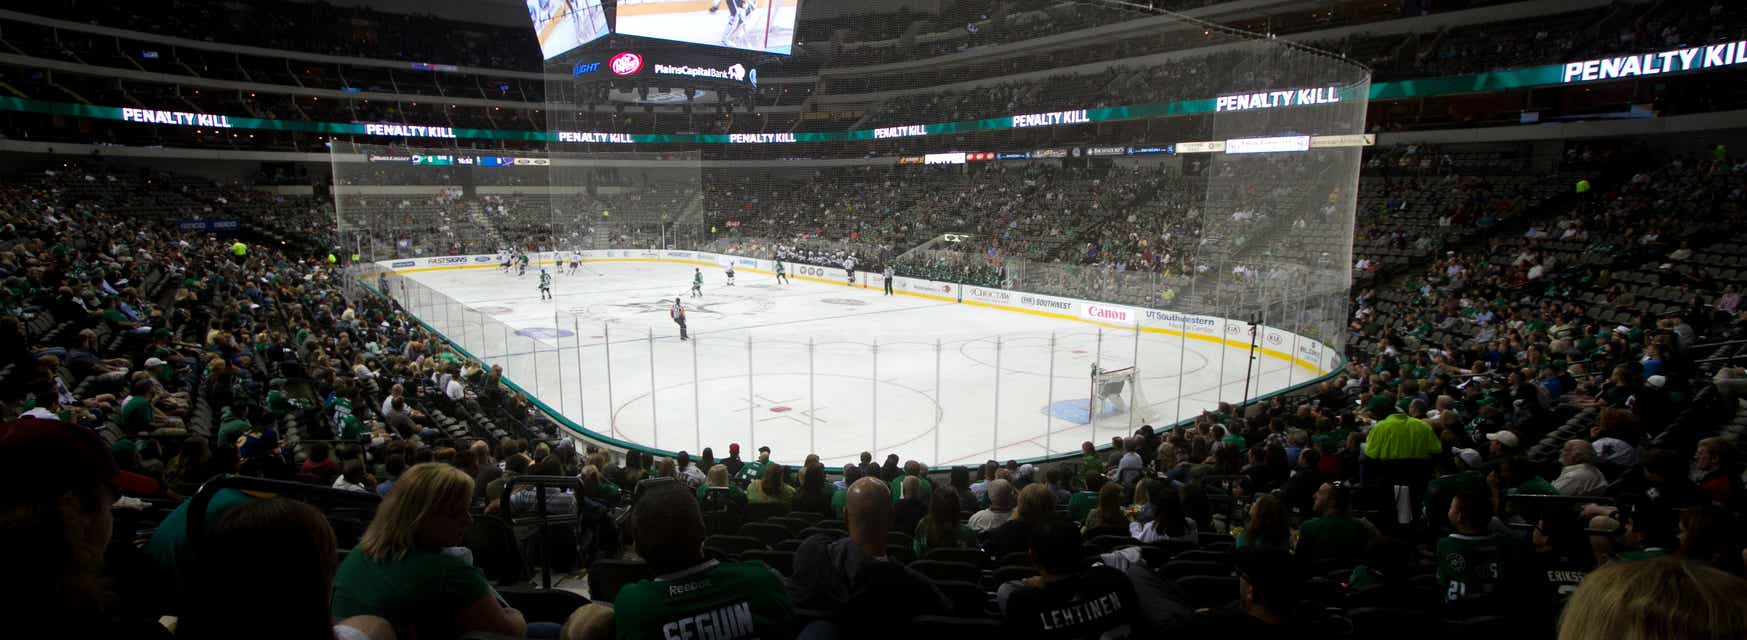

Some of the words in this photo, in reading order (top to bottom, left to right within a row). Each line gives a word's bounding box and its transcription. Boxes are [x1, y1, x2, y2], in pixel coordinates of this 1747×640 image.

[1564, 47, 1699, 83] PENALTY
[1216, 91, 1295, 112] PENALTY
[1297, 86, 1340, 105] KILL
[122, 107, 194, 126] PENALTY
[197, 113, 232, 128] KILL
[1012, 112, 1062, 128] PENALTY
[1063, 109, 1090, 124] KILL
[366, 124, 427, 138] PENALTY
[428, 127, 456, 138] KILL
[558, 132, 608, 143] PENALTY
[609, 133, 634, 143] KILL
[730, 134, 773, 143] PENALTY
[775, 133, 797, 143] KILL
[874, 126, 909, 139] PENALTY
[909, 125, 927, 137] KILL
[1036, 298, 1072, 310] SOUTHWEST
[1088, 305, 1127, 321] Canon
[1041, 591, 1122, 630] LEHTINEN
[662, 601, 753, 640] SEGUIN
